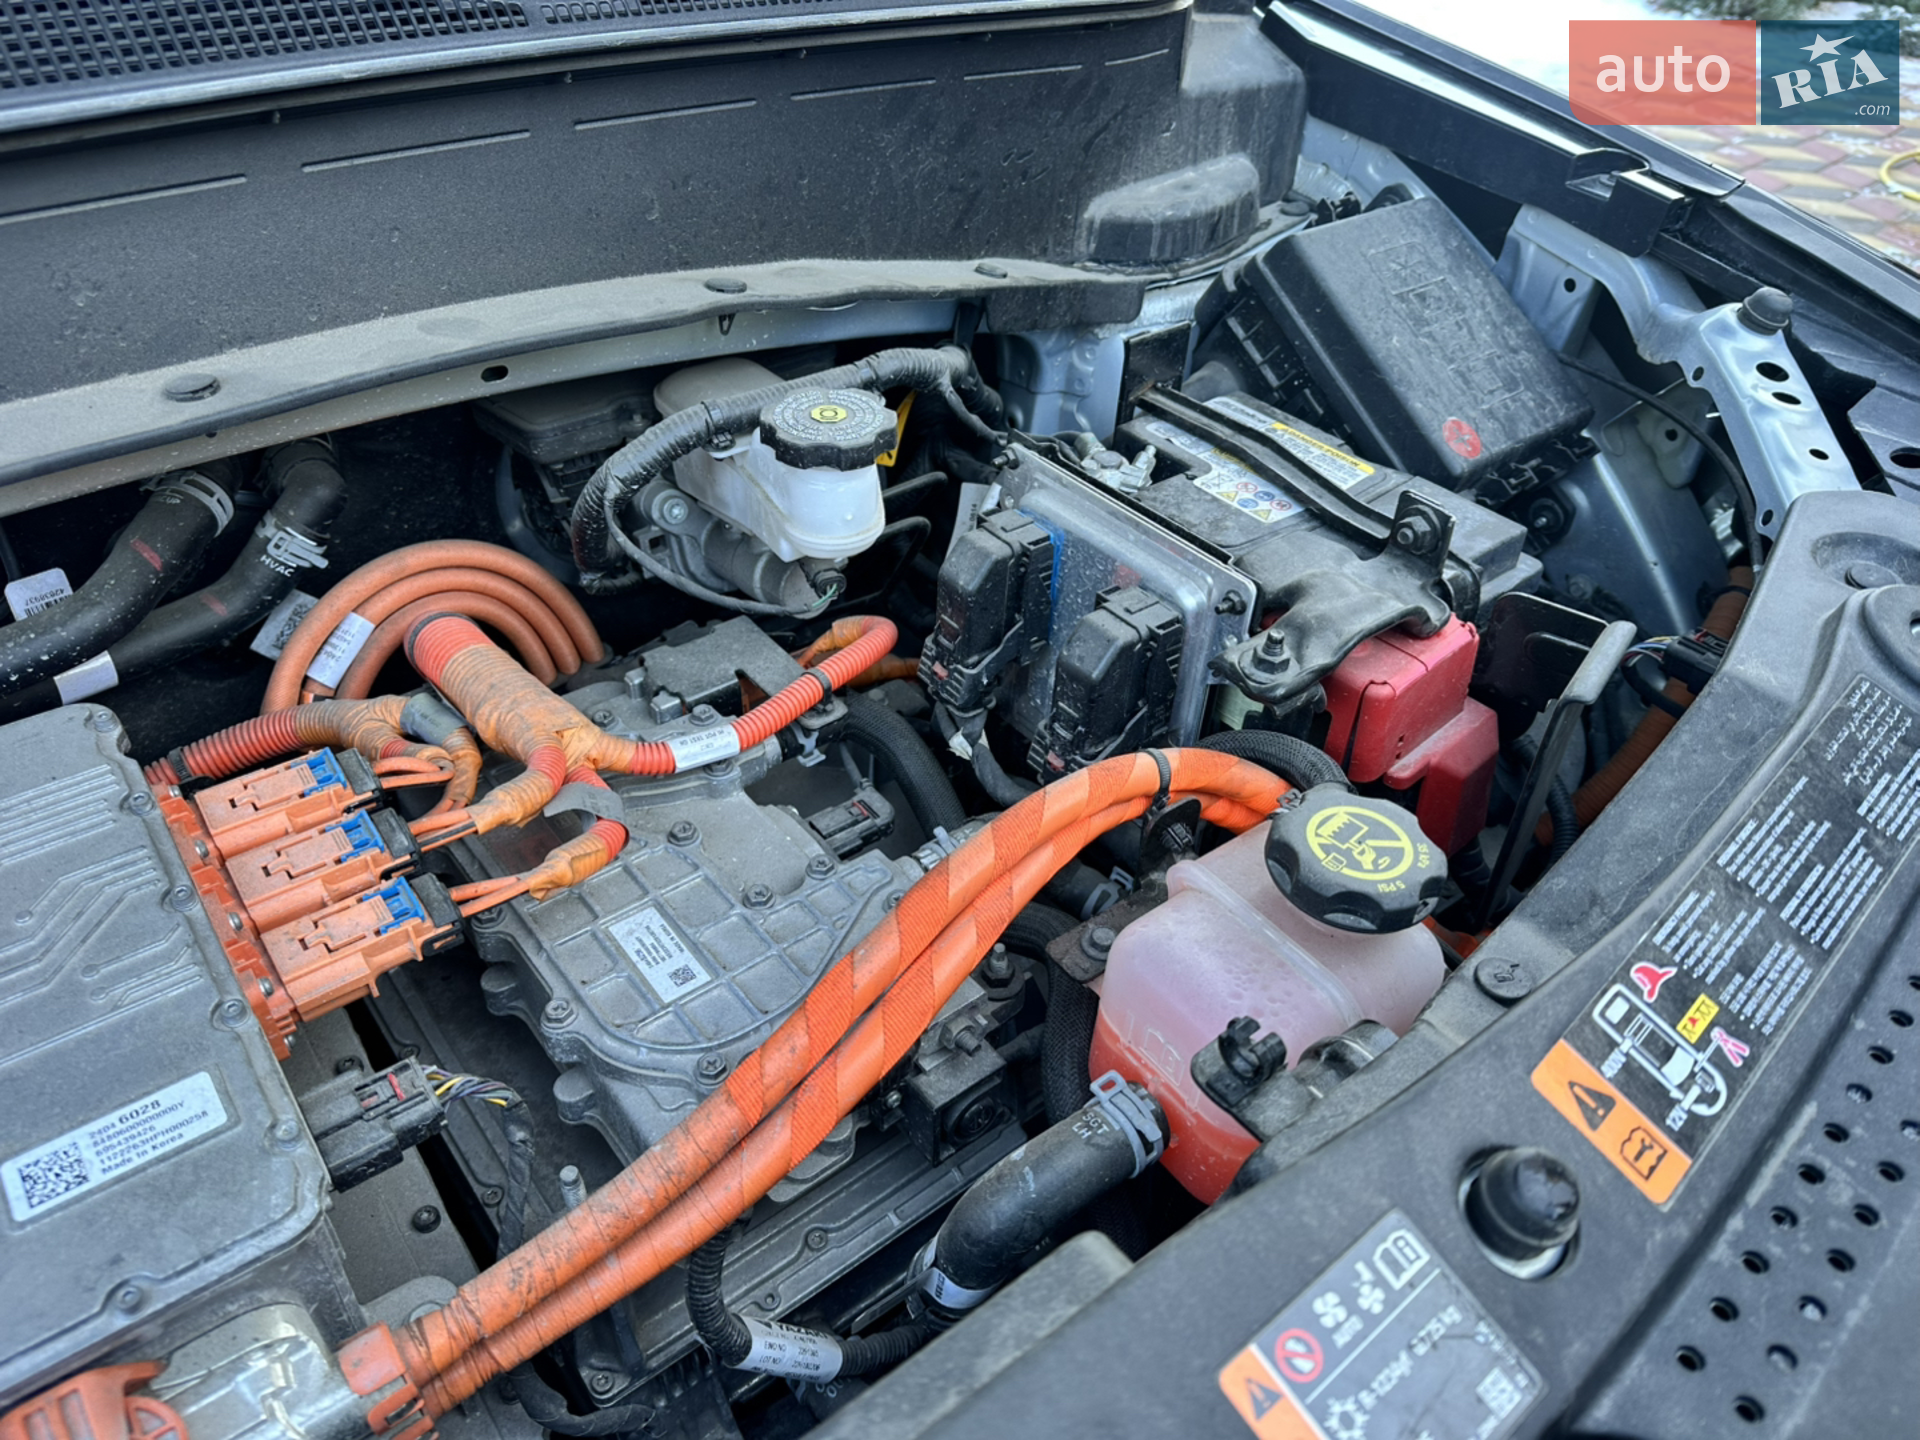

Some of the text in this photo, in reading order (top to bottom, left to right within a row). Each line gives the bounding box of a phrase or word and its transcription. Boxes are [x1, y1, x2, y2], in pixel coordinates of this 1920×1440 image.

[260, 554, 296, 577] HVAC
[117, 1098, 161, 1125] 6028
[1082, 1111, 1110, 1134] SGT
[1072, 1122, 1092, 1139] LH
[101, 1155, 133, 1175] Made
[151, 1131, 184, 1151] Korea
